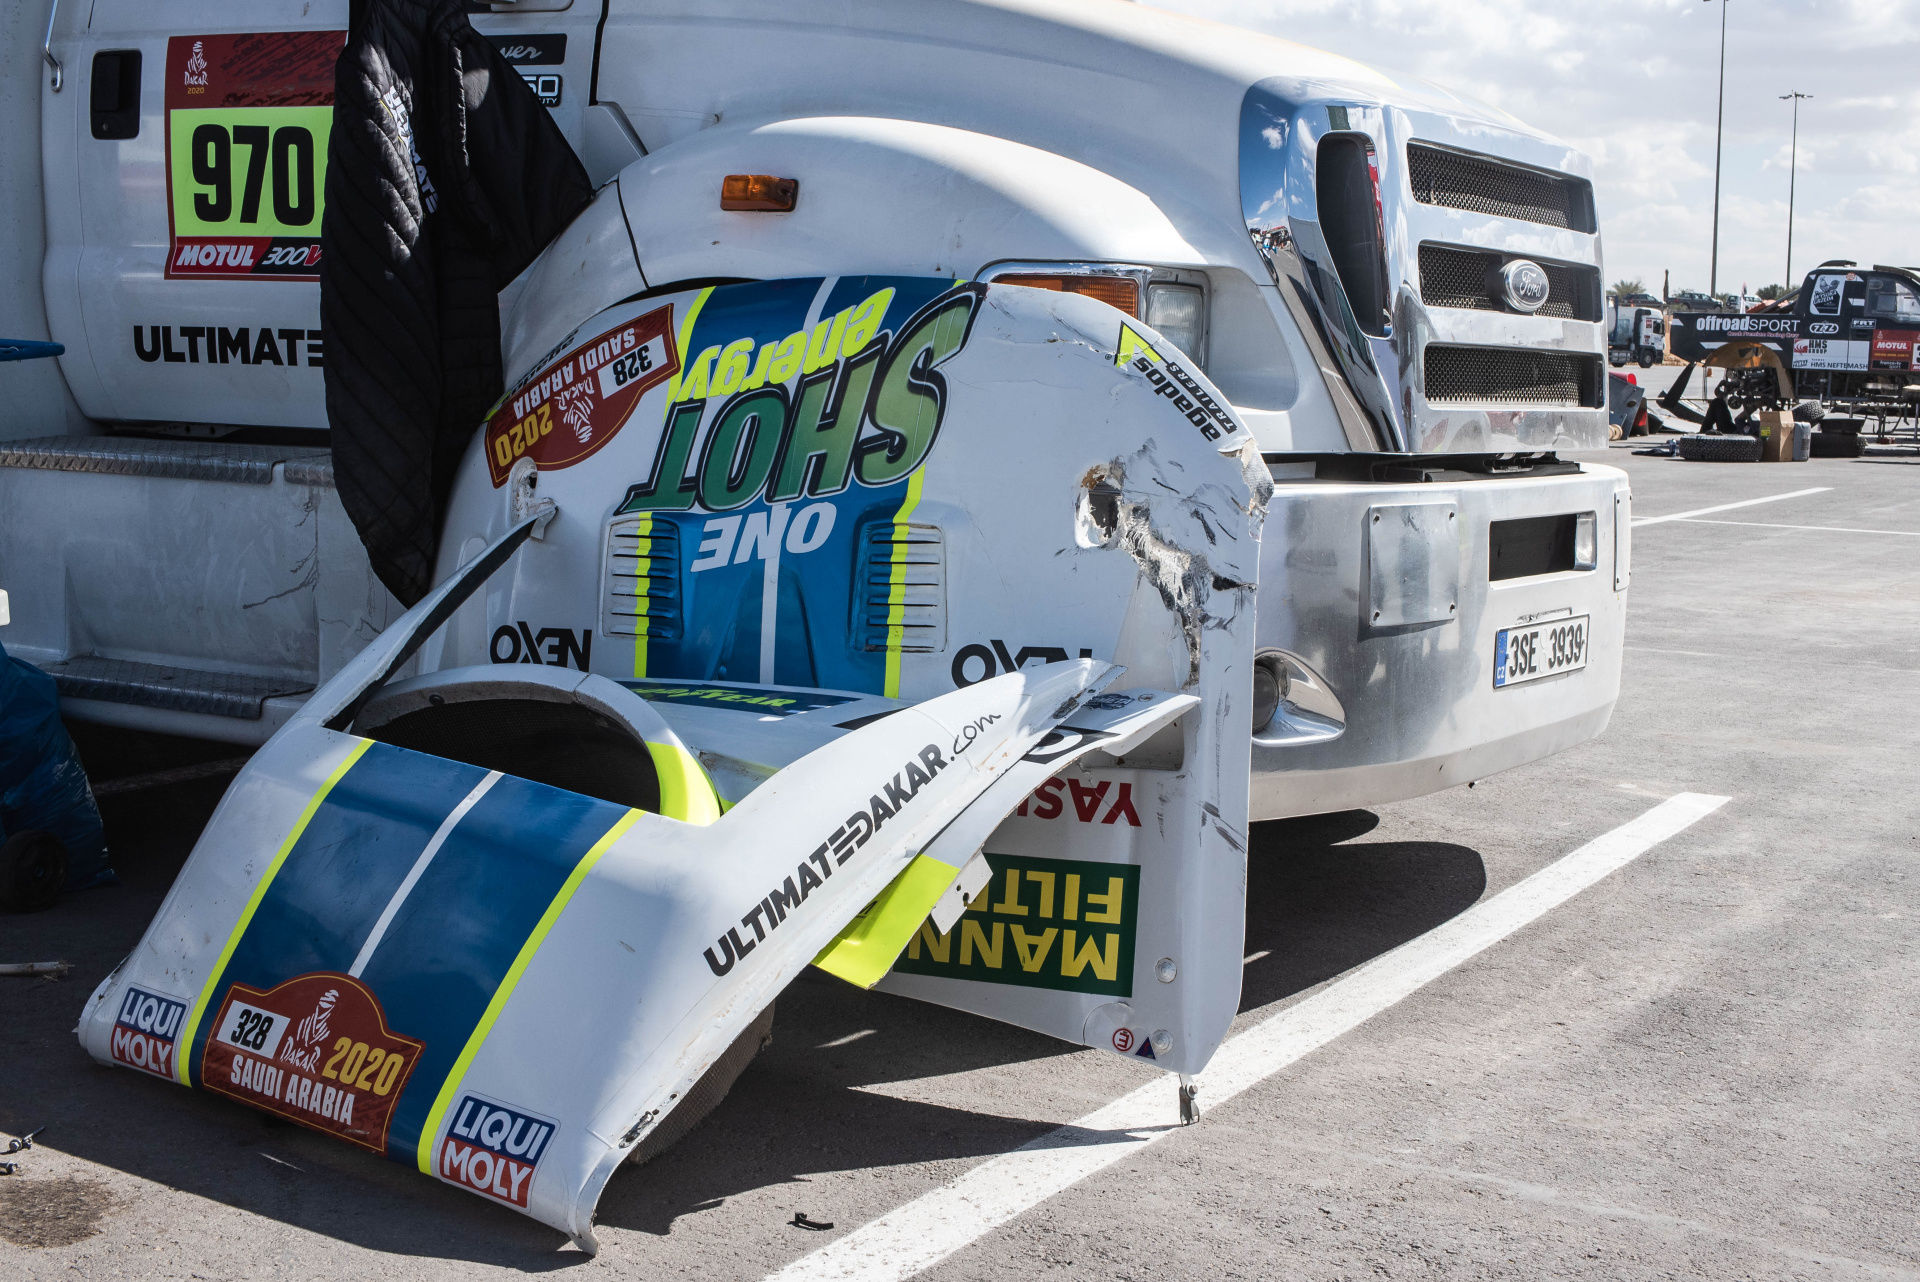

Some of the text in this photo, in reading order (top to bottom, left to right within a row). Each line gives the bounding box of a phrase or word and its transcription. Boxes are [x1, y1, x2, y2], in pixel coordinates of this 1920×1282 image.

[184, 72, 208, 85] DAKAR
[187, 87, 204, 95] 2020
[192, 124, 314, 226] 970
[176, 245, 323, 266] MOTUL 300V
[1520, 270, 1542, 298] Ford
[675, 287, 896, 402] energy
[1696, 315, 1800, 332] offroadSPORT
[1808, 339, 1828, 349] HMS
[1876, 341, 1908, 349] MOTUL
[580, 328, 636, 374] SAUDI
[612, 345, 653, 387] 328
[513, 363, 574, 420] ARABIA
[554, 376, 595, 410] DAKAR
[613, 282, 987, 516] SHOT
[1133, 357, 1221, 442] agados
[1170, 364, 1234, 431] TRAILERS
[495, 405, 553, 467] 2020
[690, 502, 837, 572] ONE
[1496, 666, 1505, 680] CZ
[1508, 623, 1583, 677] 3SE 3939
[908, 915, 1120, 981] MANN
[119, 991, 187, 1037] LIQUI
[230, 1008, 274, 1051] 328
[113, 1027, 173, 1074] MOLY
[280, 1035, 320, 1074] DAKAR
[322, 1036, 405, 1096] 2020
[230, 1053, 356, 1126] SAUDI ARABIA
[453, 1100, 550, 1160] LIQUI
[443, 1140, 533, 1201] MOLY
